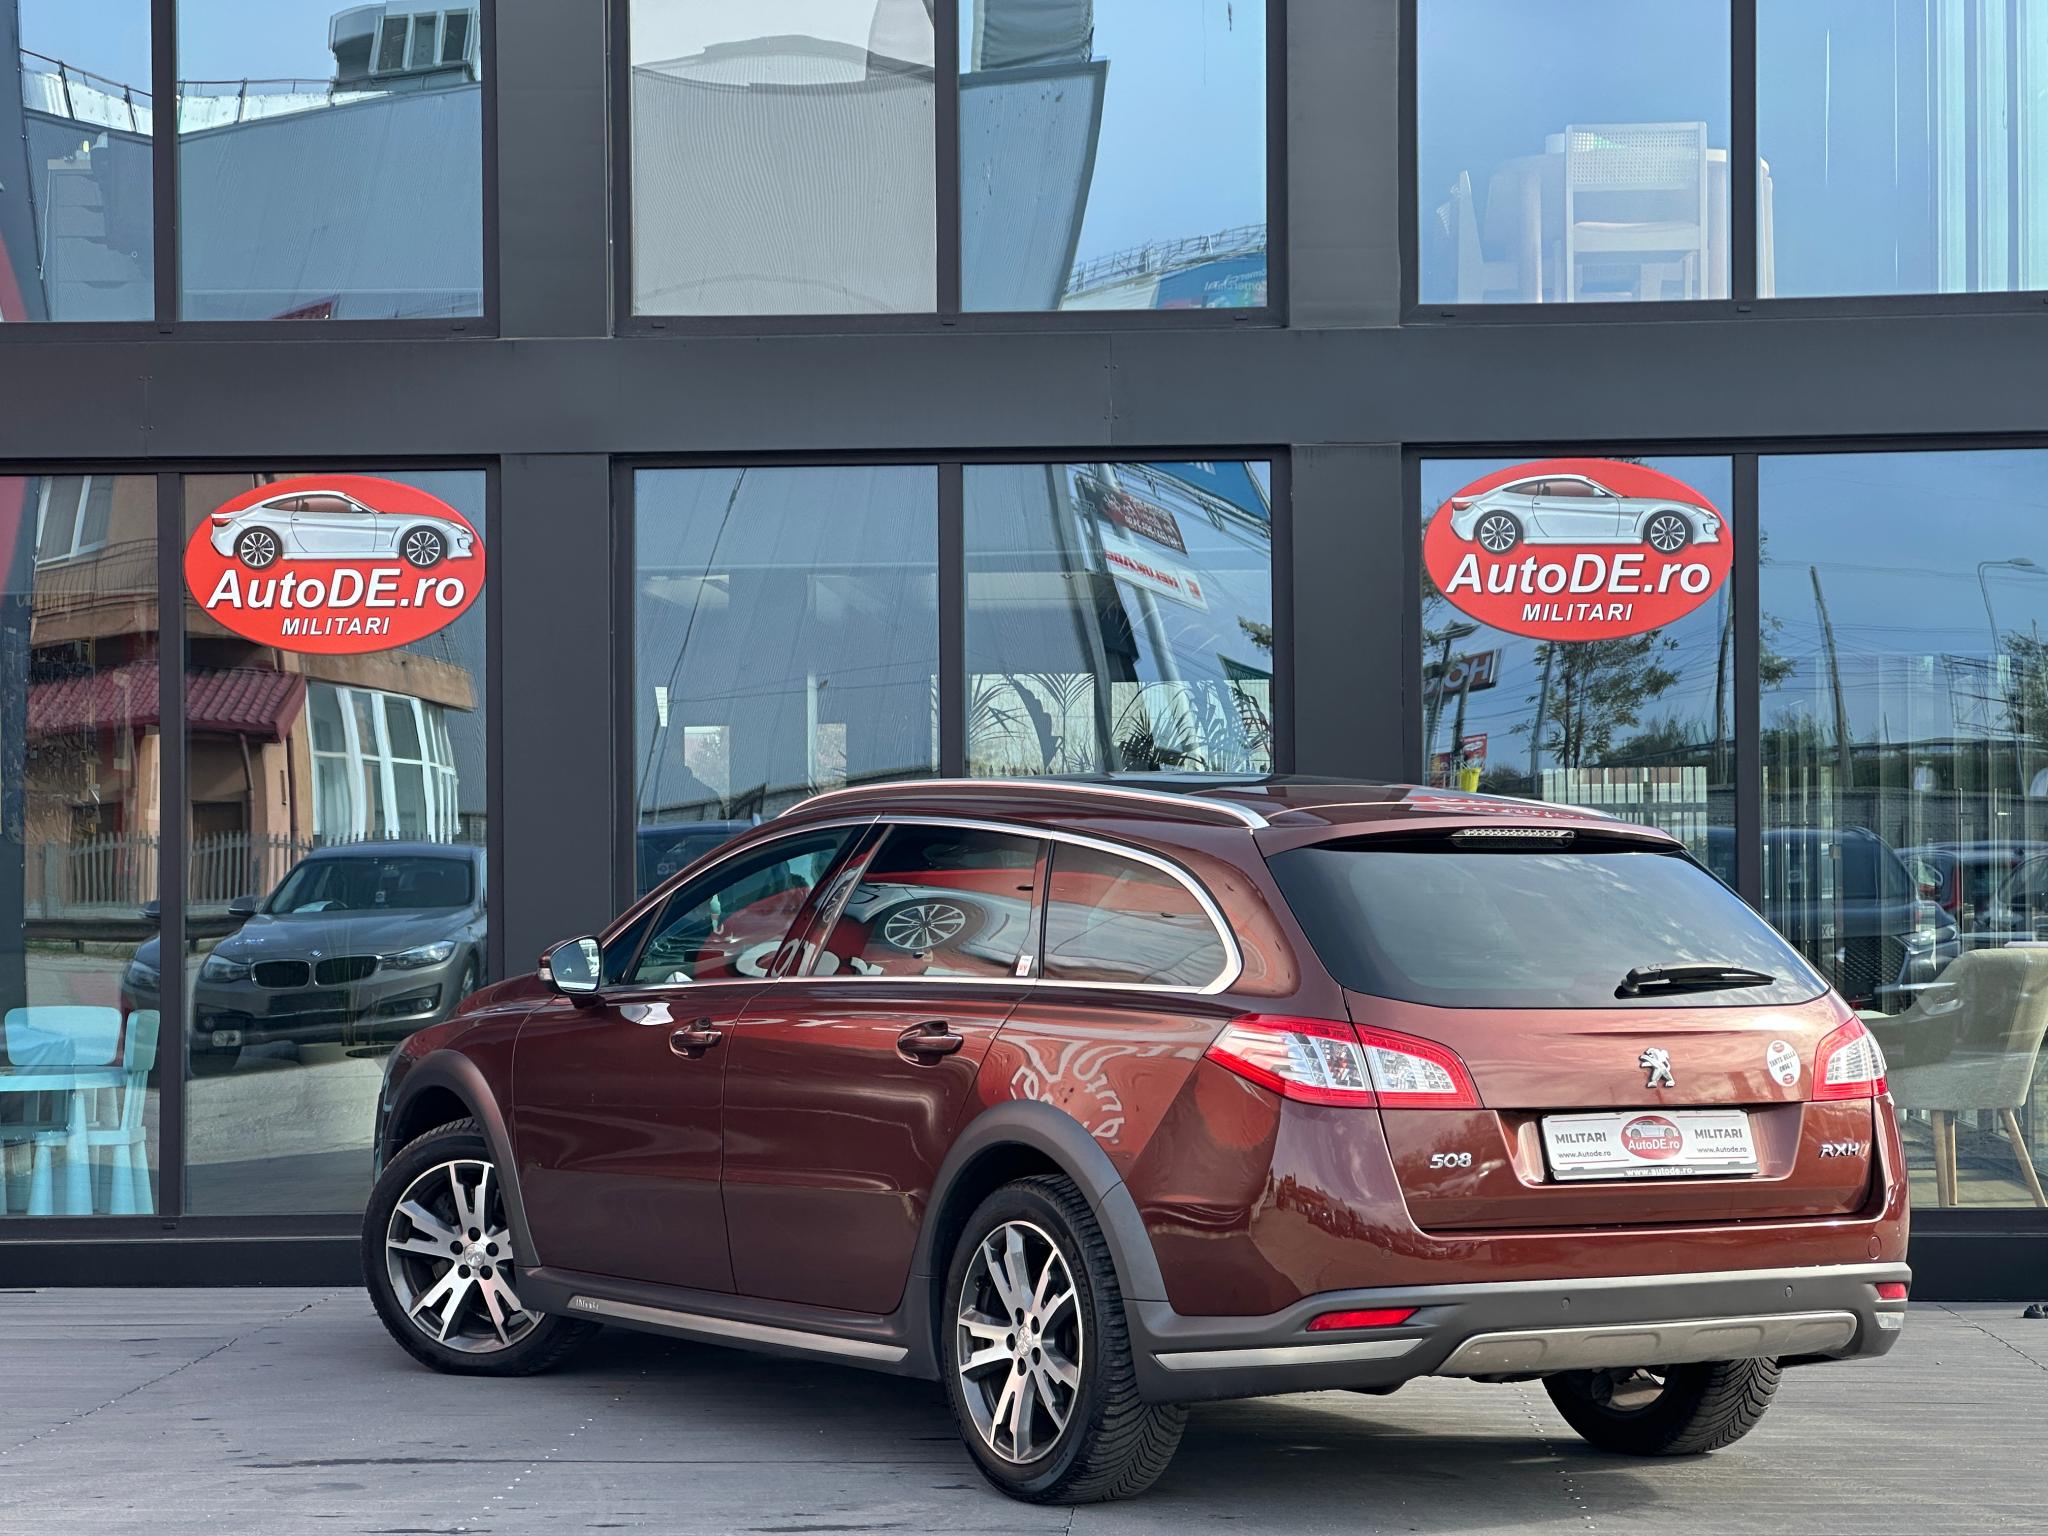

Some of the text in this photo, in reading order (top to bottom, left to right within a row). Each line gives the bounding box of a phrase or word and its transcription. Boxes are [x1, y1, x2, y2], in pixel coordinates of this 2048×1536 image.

[1446, 552, 1711, 595] AutoDE.ro
[206, 568, 465, 609] AutoDE.ro
[1522, 603, 1633, 622] MILITARI
[281, 617, 390, 636] MILITARI
[1555, 1132, 1607, 1144] MILITARI
[1694, 1128, 1743, 1139] MILITARI
[1627, 1138, 1681, 1151] AutoDE.ro
[1819, 1142, 1860, 1158] RXH
[1429, 1152, 1472, 1169] 508
[1557, 1150, 1612, 1159] www.Autode.ro
[1625, 1167, 1693, 1177] www.autode.ro
